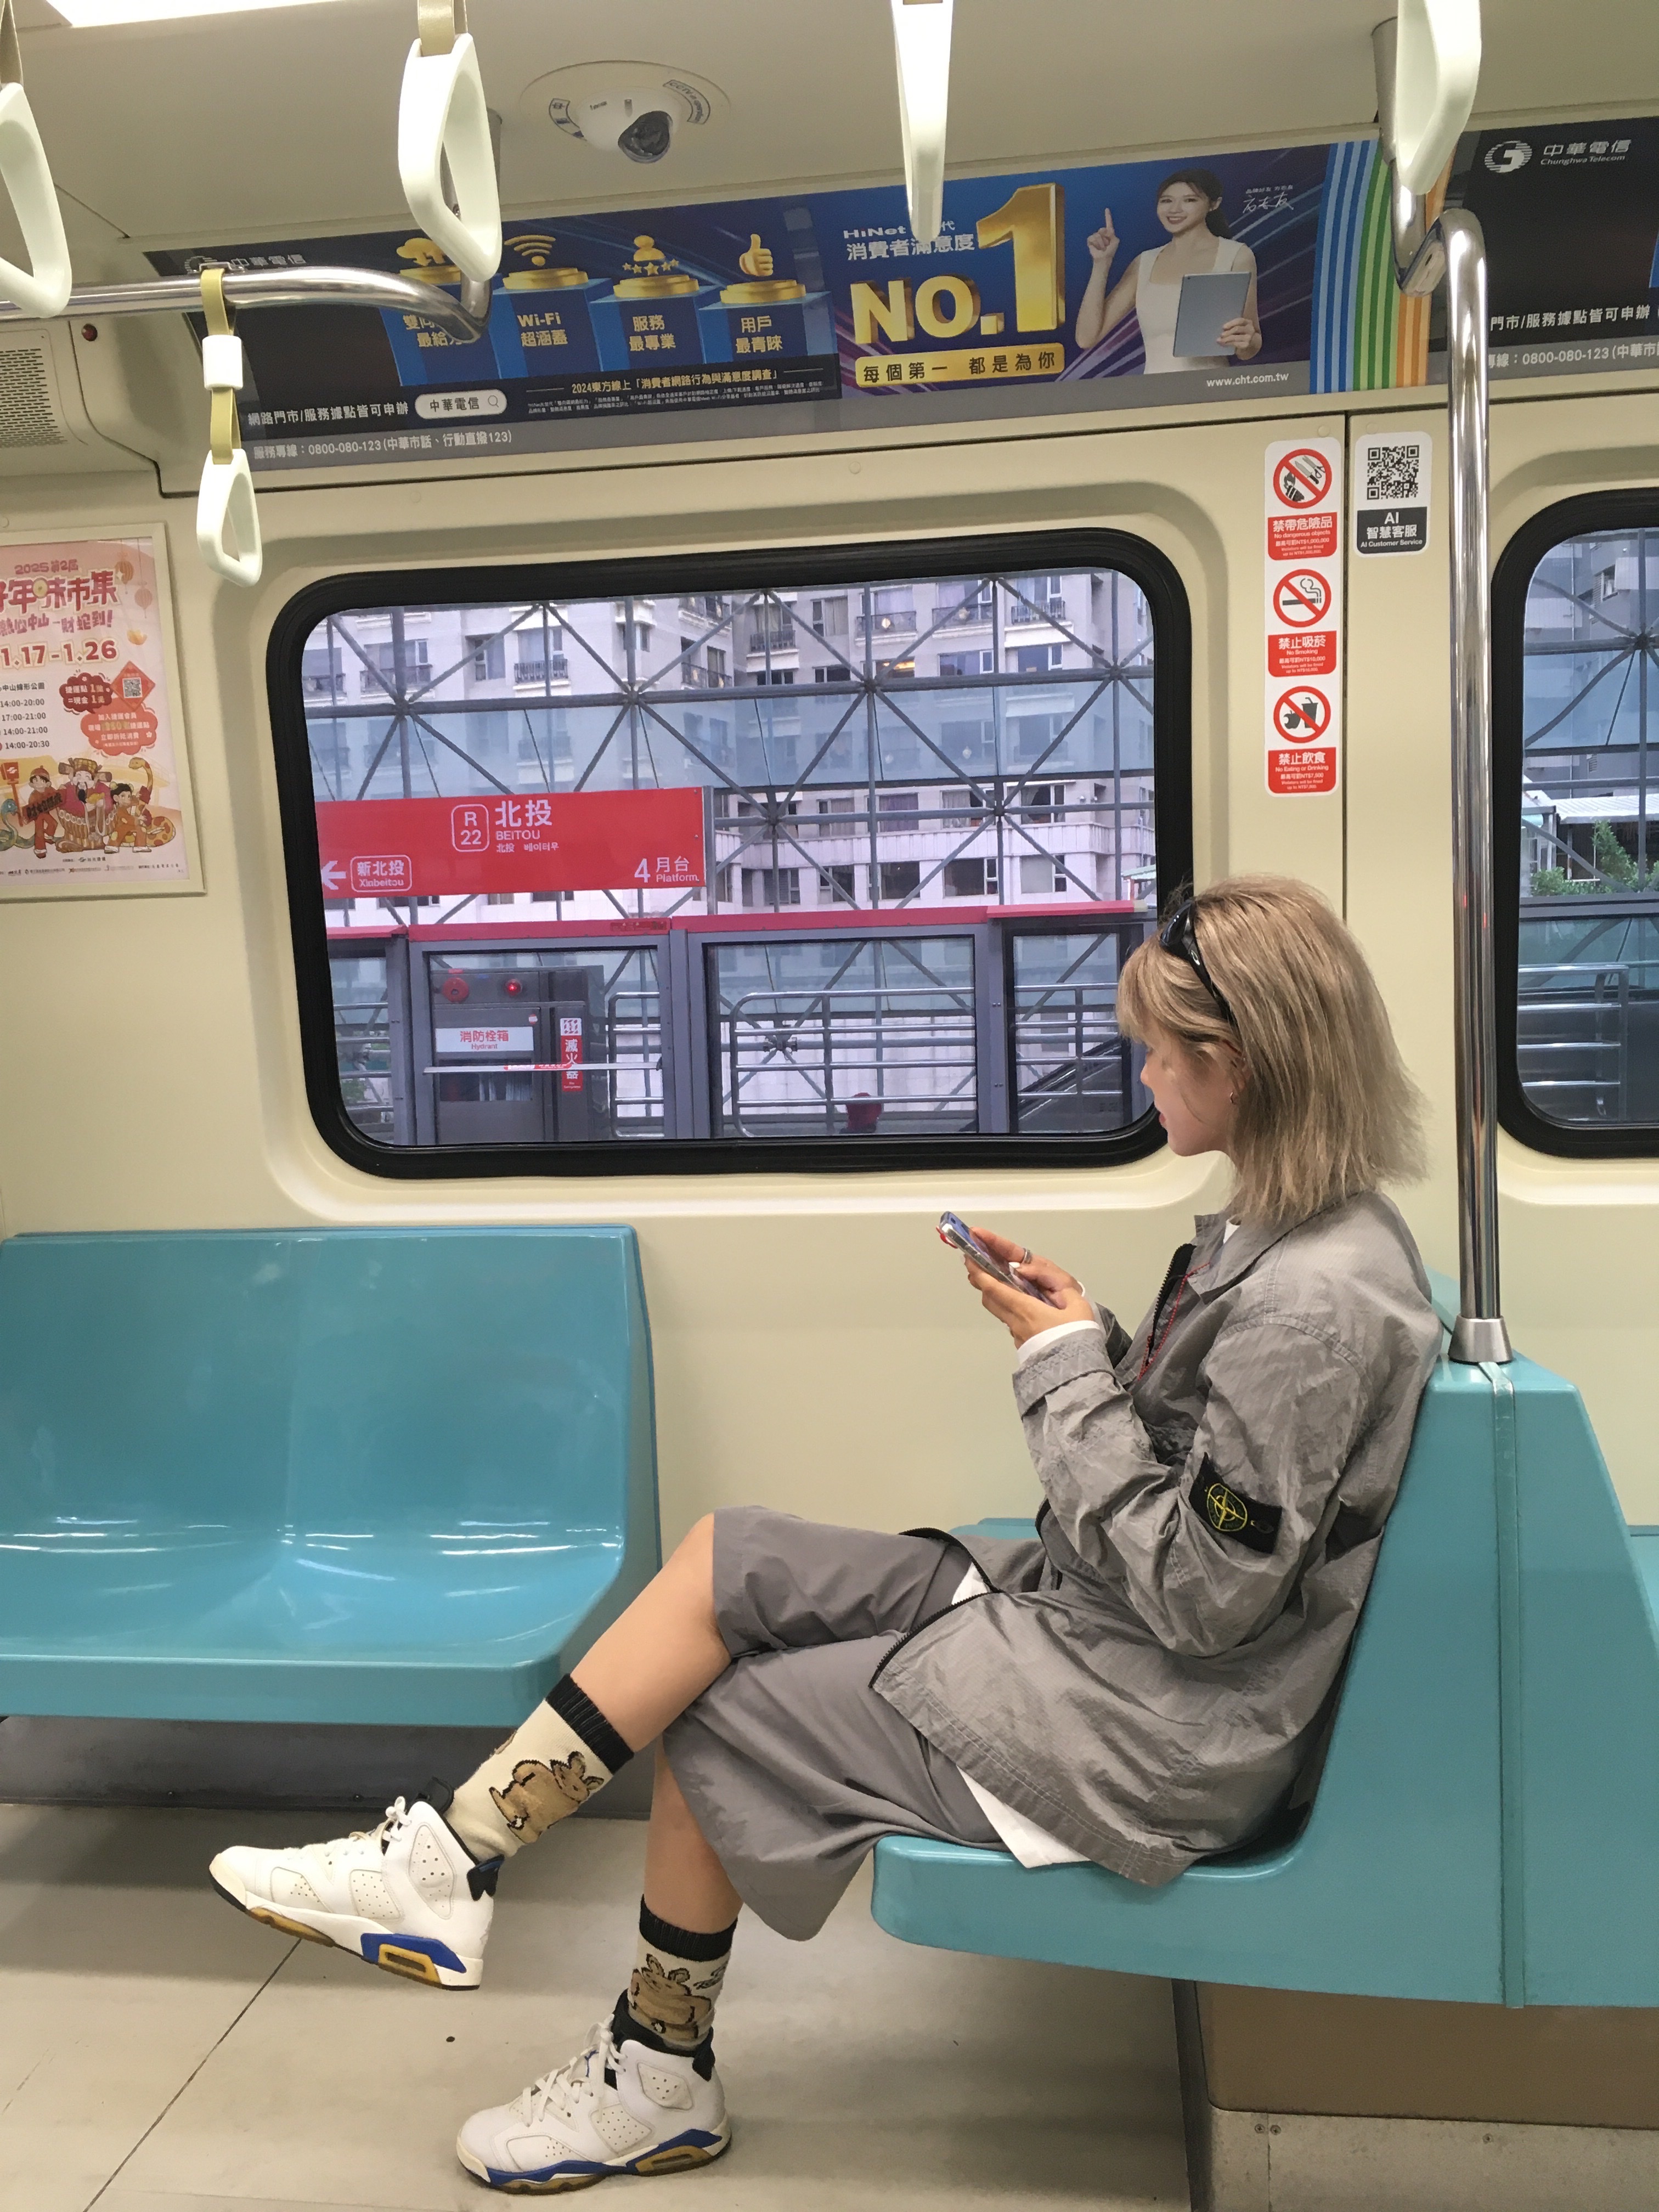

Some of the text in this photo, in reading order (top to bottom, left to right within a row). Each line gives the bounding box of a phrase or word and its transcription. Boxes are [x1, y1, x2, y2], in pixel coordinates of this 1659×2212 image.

[1543, 139, 1632, 157] 中華電信
[843, 225, 906, 239] HiNet
[847, 234, 975, 261] 消費者滿意度
[517, 312, 561, 327] Wi-Fi
[633, 314, 665, 332] 服務
[741, 315, 772, 333] 用戶
[521, 329, 568, 347] 超涵蓋
[629, 333, 676, 352] 最專業
[864, 351, 1056, 383] 每個第一 都是為你
[1206, 373, 1289, 387] www.cht.com.tw
[248, 397, 480, 426] 網路門市/服務據點皆可申辦 中華電信
[1273, 516, 1333, 533] 禁帶危險品
[1384, 511, 1400, 524] AI
[1367, 524, 1417, 540] 智慧客服
[1278, 635, 1326, 650] 禁止吸菸
[0, 682, 45, 691] 中山線形公園
[0, 698, 45, 708] 14:00-20:00
[2, 712, 47, 721] 17:00-21:00
[3, 726, 48, 735] 14:00-21:00
[5, 740, 50, 749] 14:00-20:30
[1278, 751, 1326, 765] 禁止飲食
[465, 811, 477, 826] R
[495, 799, 552, 828] 北投
[460, 829, 482, 845] 22
[495, 830, 540, 840] BEITOU
[496, 842, 515, 853] 北投
[357, 860, 405, 877] 新北投
[634, 856, 690, 883] 4 月台
[359, 878, 405, 887] Xinbeitou
[656, 873, 697, 882] Platform
[460, 1030, 509, 1043] 消防栓箱
